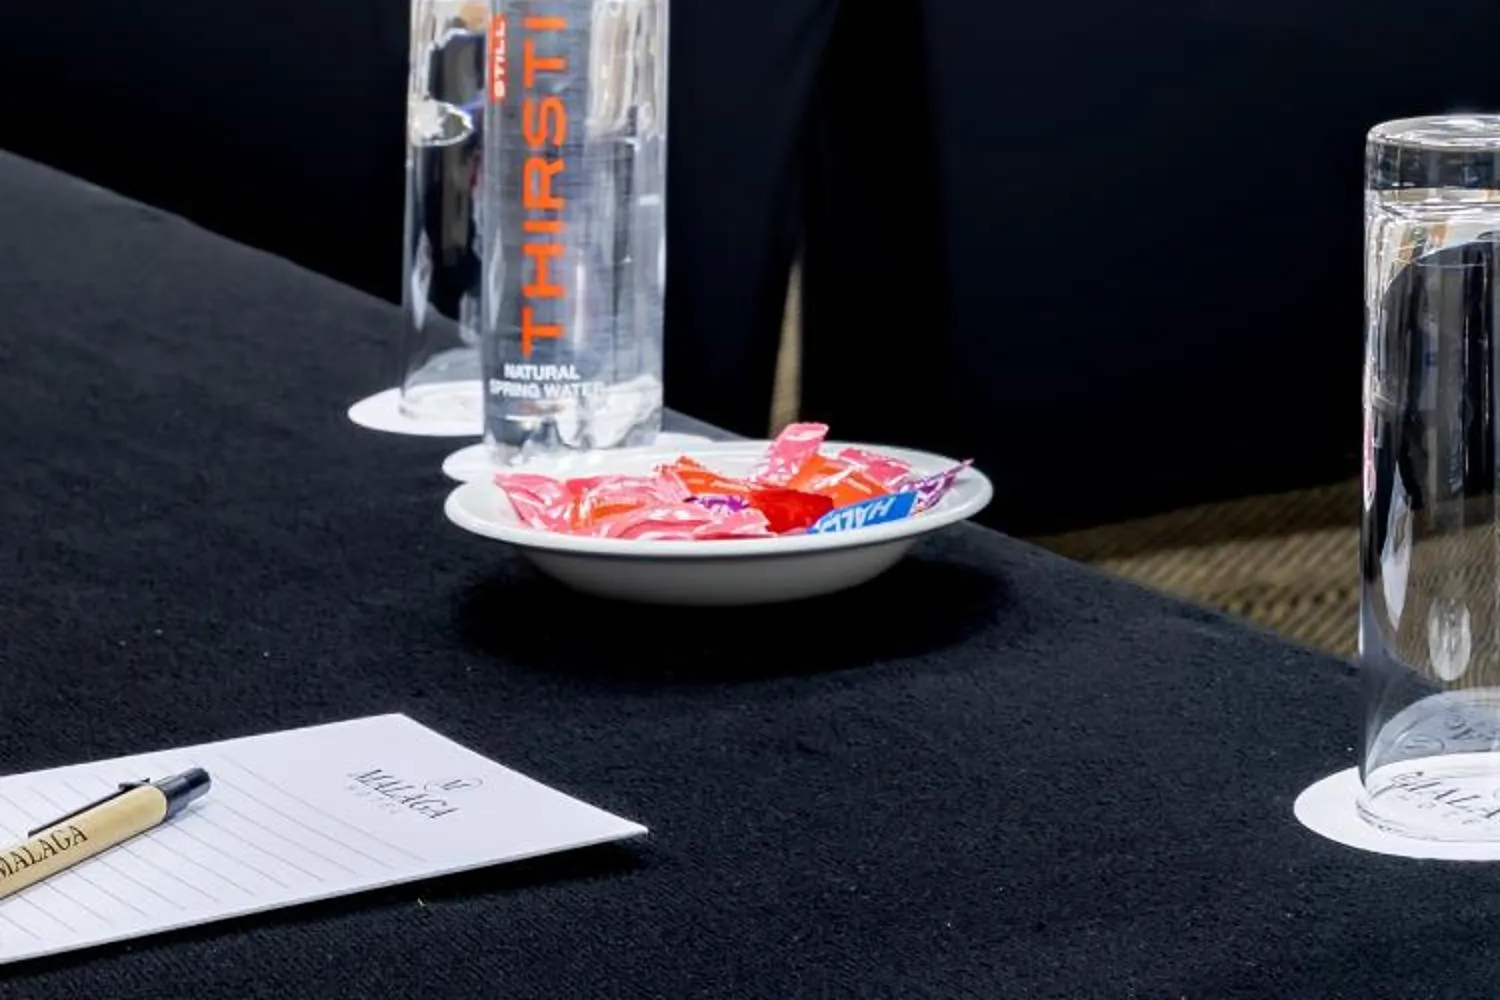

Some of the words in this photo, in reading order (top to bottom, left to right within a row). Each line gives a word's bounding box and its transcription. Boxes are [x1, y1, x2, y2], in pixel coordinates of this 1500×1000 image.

[521, 14, 569, 359] THIRSTI
[503, 364, 581, 381] NATURAL
[489, 378, 541, 399] SPRING
